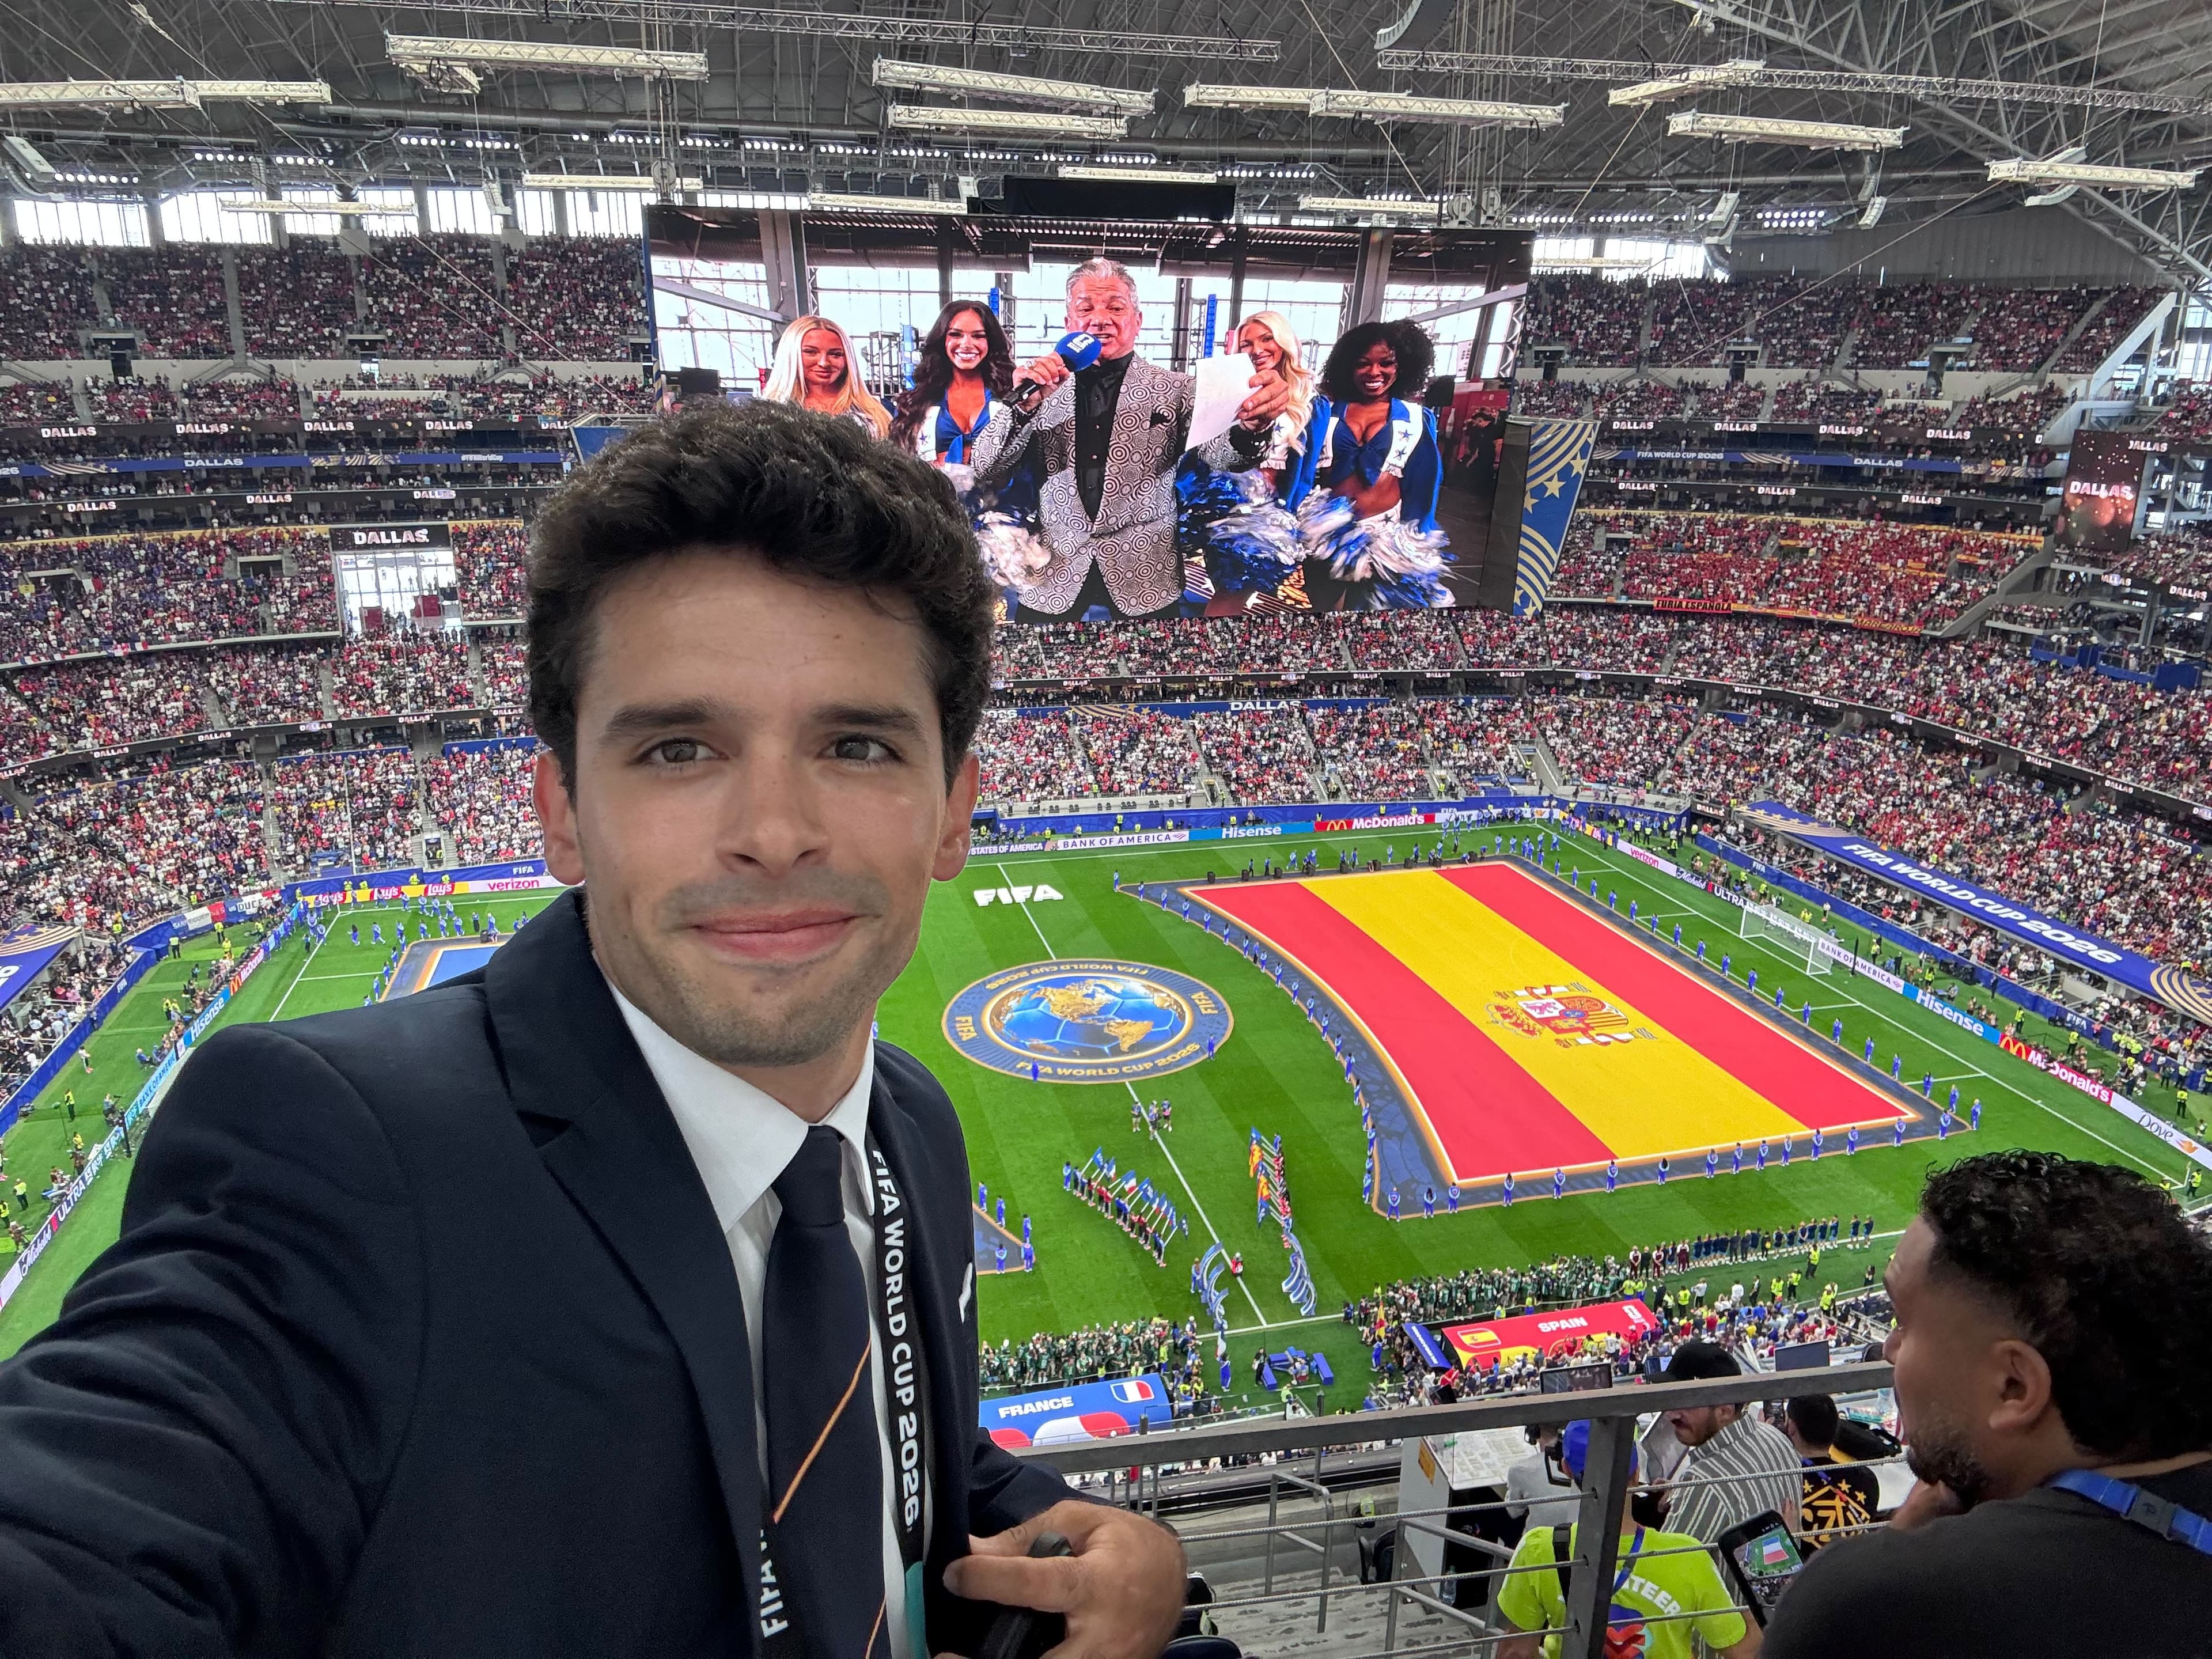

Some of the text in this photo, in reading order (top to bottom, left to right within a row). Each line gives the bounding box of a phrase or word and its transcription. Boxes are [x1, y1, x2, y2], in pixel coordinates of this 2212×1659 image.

[176, 423, 228, 433] DALLAS
[304, 422, 354, 431] DALLAS
[426, 421, 473, 430] DALLAS
[1612, 422, 1653, 430] DALLAS
[1714, 422, 1756, 431] DALLAS
[1819, 425, 1863, 435] DALLAS
[41, 427, 96, 437] DALLAS
[1926, 429, 1971, 440] DALLAS
[1654, 452, 1680, 460] WORLD
[184, 459, 243, 467] DALLAS
[1854, 457, 1903, 467] DALLAS
[1618, 483, 1655, 491] DALLAS
[1758, 487, 1796, 495] DALLAS
[2070, 480, 2134, 499] DALLAS
[247, 494, 291, 503] DALLAS
[413, 490, 456, 499] DALLAS
[1902, 494, 1942, 505] DALLAS
[67, 502, 116, 512] DALLAS
[353, 529, 429, 545] DALLAS
[2170, 585, 2207, 601] DALLAS
[1656, 600, 1683, 609] FURIA
[1654, 677, 1681, 685] DALLAS
[1734, 686, 1762, 695] DALLAS
[1230, 700, 1301, 711] DALLAS
[1813, 698, 1839, 708] DALLAS
[399, 714, 431, 723] DALLAS
[1891, 714, 1912, 725] DALLAS
[300, 722, 332, 730] DALLAS
[198, 732, 231, 741] DALLAS
[1955, 733, 1978, 745] DALLAS
[93, 748, 128, 758] DALLAS
[2026, 756, 2052, 769] DALLAS
[2105, 779, 2134, 794] DALLAS
[1696, 804, 1725, 816] DALLAS
[1352, 813, 1425, 830] McDonald's
[1222, 825, 1282, 838] Hisense
[1063, 833, 1171, 849] BANK OF AMERICA
[971, 843, 1043, 855] STATES OF AMERICA
[1630, 847, 1659, 869] verizon
[513, 866, 535, 875] FIFA
[1752, 862, 1766, 873] FIFA
[428, 883, 452, 896] Lay's
[487, 877, 539, 891] verizon
[974, 885, 1063, 906] FIFA
[1714, 887, 1745, 908] ULTRA
[1842, 843, 2124, 964] FIFA WORLD CUP 2026
[1821, 941, 1840, 960] BANK
[191, 997, 224, 1038] Hisense
[1916, 989, 1984, 1036] Hisense
[2066, 1012, 2087, 1029] FIFA
[956, 1016, 978, 1041] FIFA
[1056, 1066, 1119, 1076] WORLD
[1125, 1062, 1154, 1073] CUP
[1154, 1043, 1200, 1068] 2026
[2138, 1114, 2173, 1142] Dove
[58, 1181, 86, 1222] ULTRA
[1538, 1317, 1588, 1332] SPAIN
[872, 1150, 919, 1526] FIFA WORLD CUP 2026
[998, 1396, 1074, 1419] FRANCE
